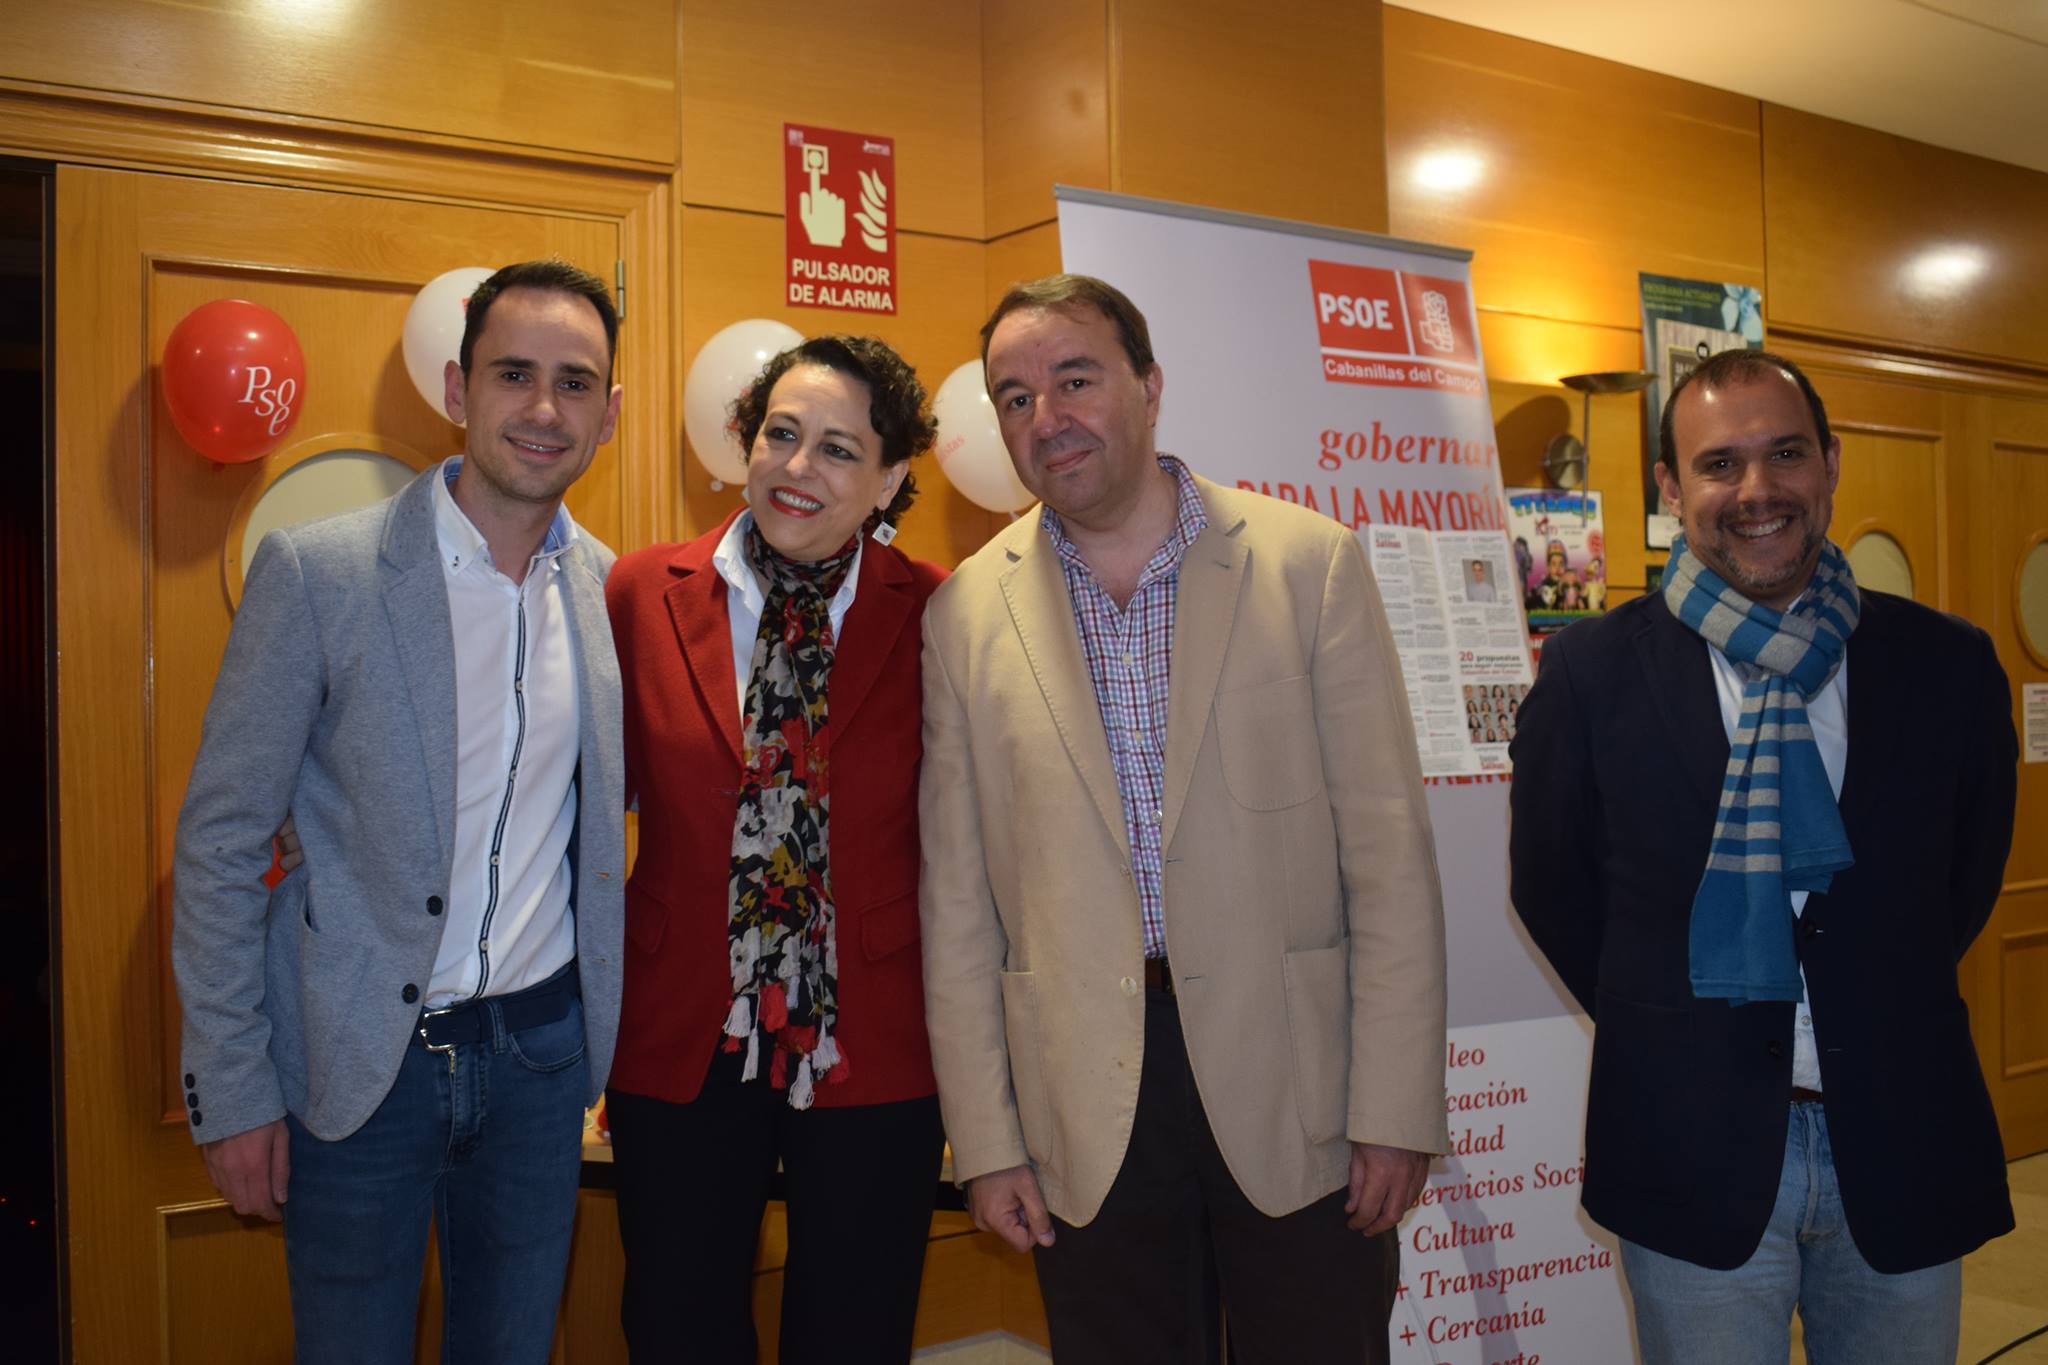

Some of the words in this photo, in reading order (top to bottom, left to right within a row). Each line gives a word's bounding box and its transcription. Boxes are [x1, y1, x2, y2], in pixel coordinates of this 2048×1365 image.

[792, 258, 890, 286] PULSADOR
[789, 283, 814, 303] DE
[818, 286, 894, 311] ALARMA
[1318, 292, 1393, 331] PSOE
[1325, 358, 1405, 381] Cabanillas
[1408, 365, 1432, 384] del
[1317, 421, 1496, 472] gobernar
[1330, 485, 1371, 531] LA
[1459, 650, 1474, 662] 20
[1413, 1218, 1516, 1254] Cultura
[1420, 1244, 1613, 1299] Transparencia
[1427, 1301, 1546, 1344] Cercanía
